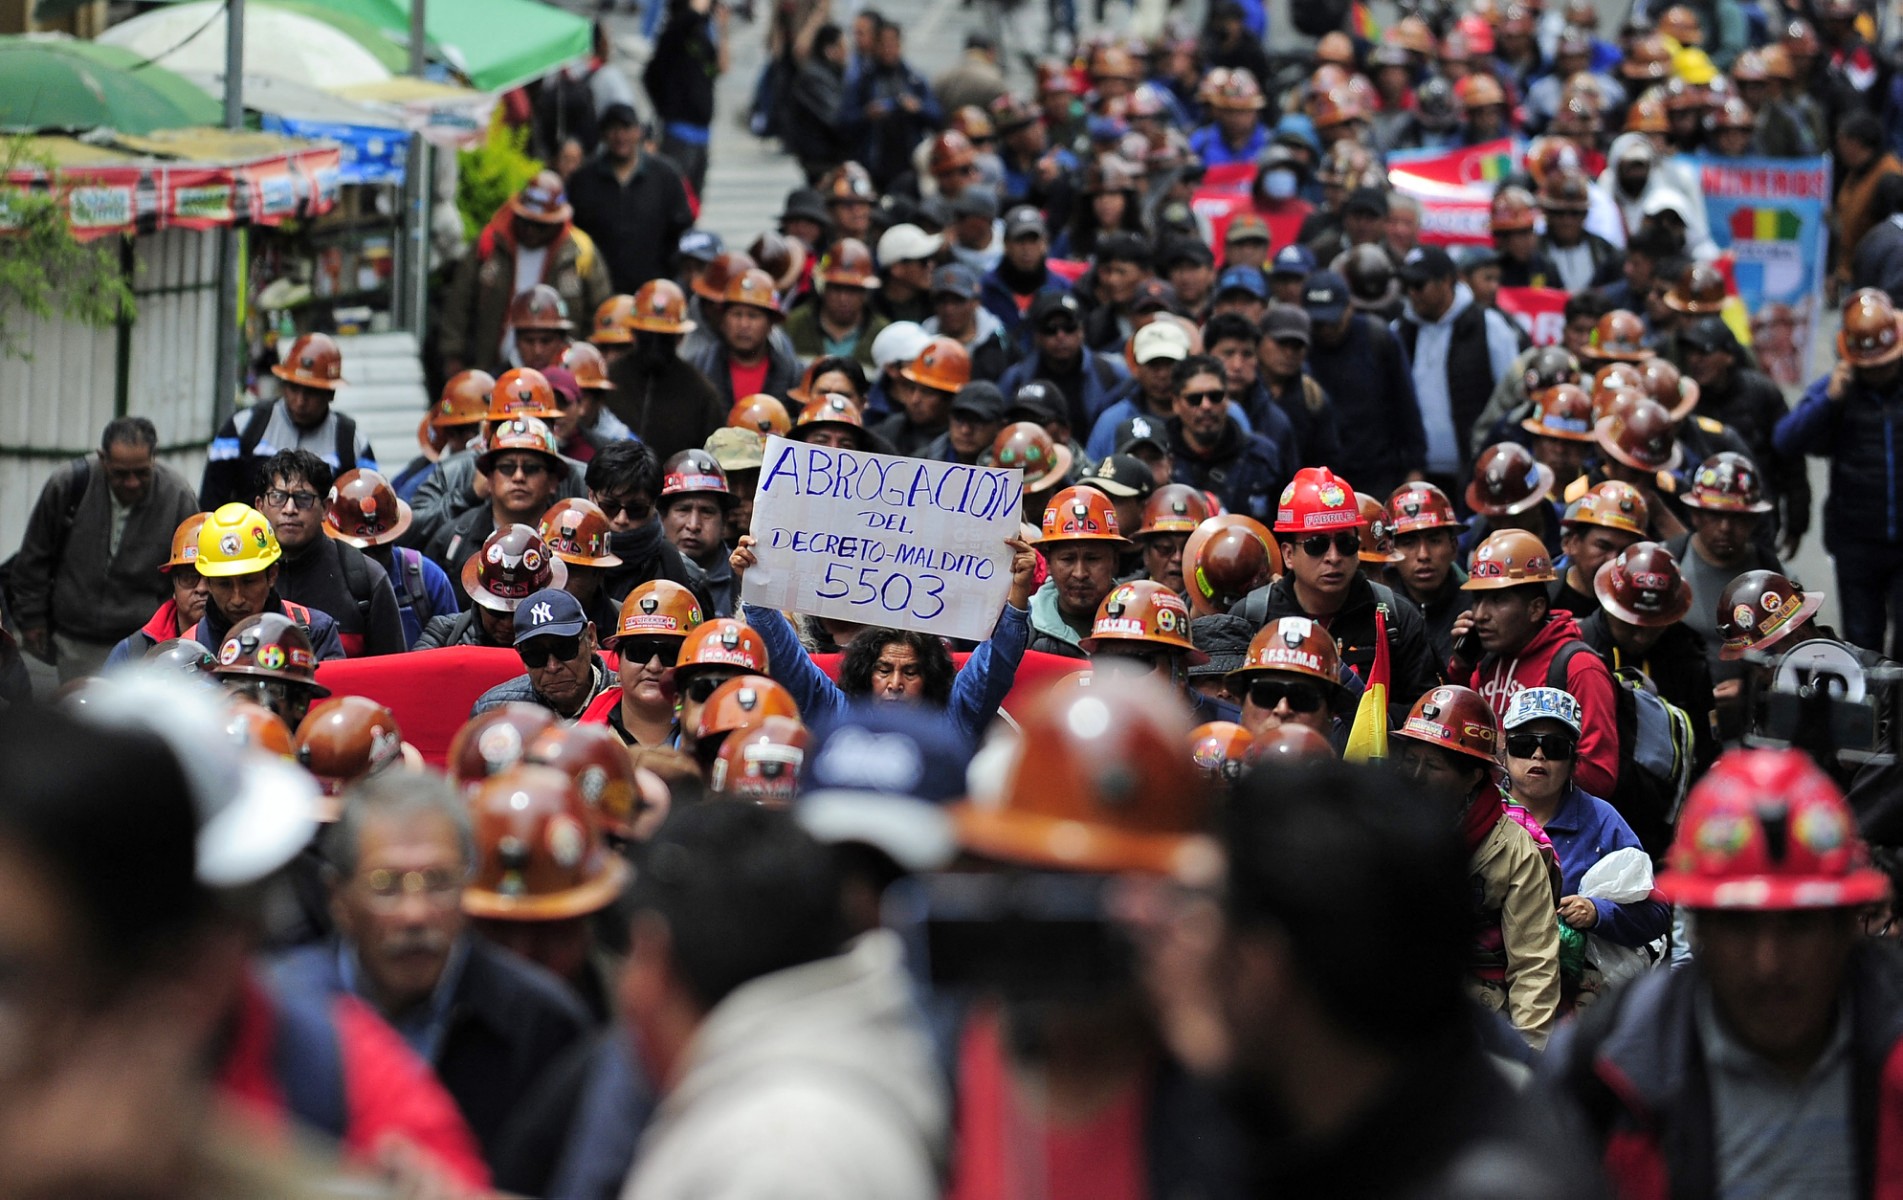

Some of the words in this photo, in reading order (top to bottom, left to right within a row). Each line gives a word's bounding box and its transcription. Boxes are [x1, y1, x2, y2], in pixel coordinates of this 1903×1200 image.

[762, 447, 1024, 521] ABROGACIÓN
[857, 511, 913, 534] DEL
[815, 562, 945, 619] 5503
[530, 601, 554, 625] NY
